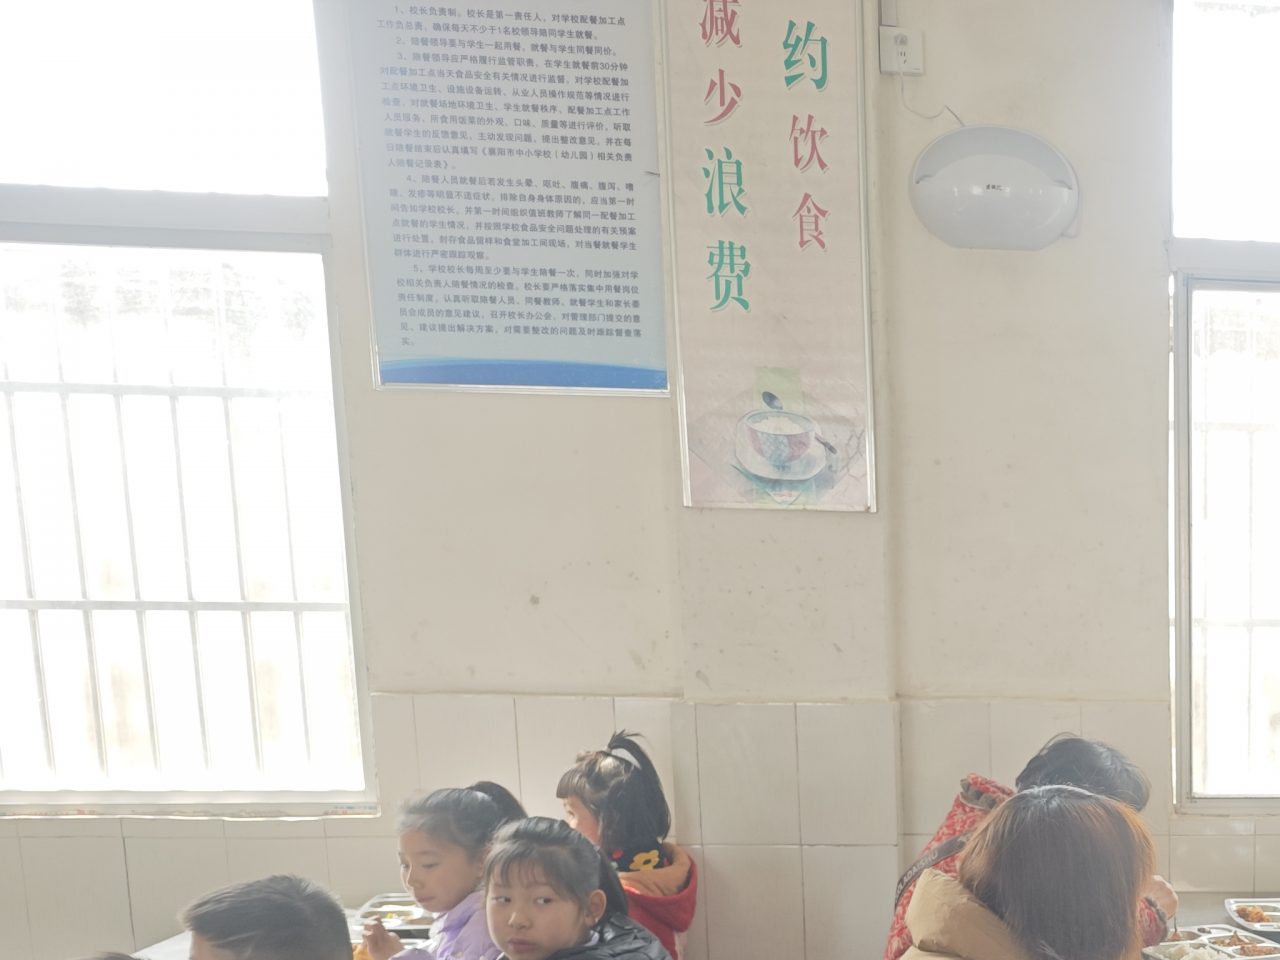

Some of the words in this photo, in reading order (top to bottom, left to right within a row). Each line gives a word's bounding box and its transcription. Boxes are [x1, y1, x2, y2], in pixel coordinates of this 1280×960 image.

[699, 0, 752, 313] 减少浪费
[782, 19, 829, 251] 约饮食
